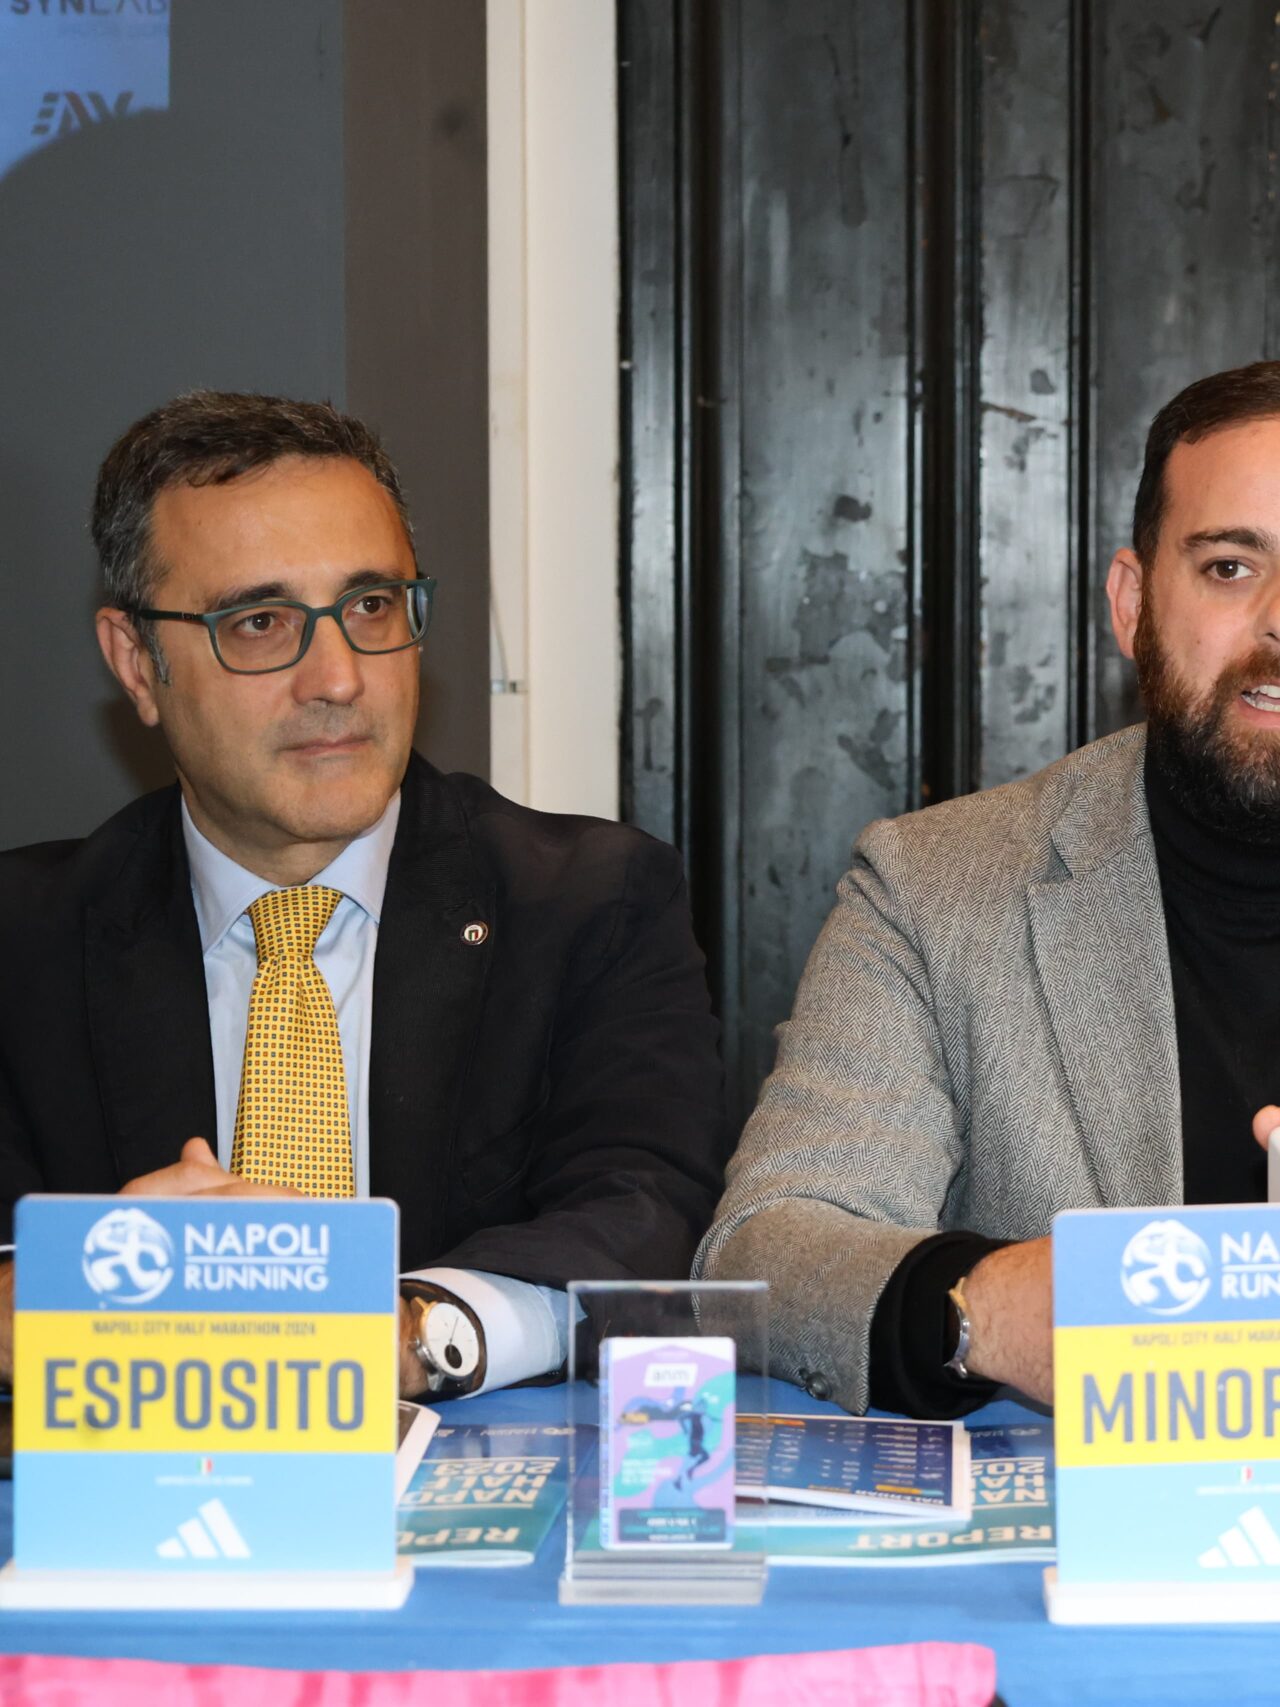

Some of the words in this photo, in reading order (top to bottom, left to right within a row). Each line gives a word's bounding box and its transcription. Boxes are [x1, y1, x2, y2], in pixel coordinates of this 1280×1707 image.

[184, 1222, 330, 1256] NAPOLI
[184, 1263, 329, 1291] RUNNING
[93, 1320, 137, 1335] NAPOLI
[144, 1320, 170, 1335] CITY
[175, 1320, 205, 1335] HALF
[210, 1320, 280, 1335] MARATHON
[285, 1320, 316, 1335] 2024
[1132, 1331, 1176, 1346] NAPOLI
[1182, 1330, 1208, 1345] CITY
[1213, 1329, 1243, 1344] HALF
[652, 1369, 690, 1382] anm
[44, 1358, 365, 1431] ESPOSITO
[432, 1461, 557, 1476] 2023
[421, 1475, 547, 1490] HALF
[848, 1525, 1053, 1550] REPORT
